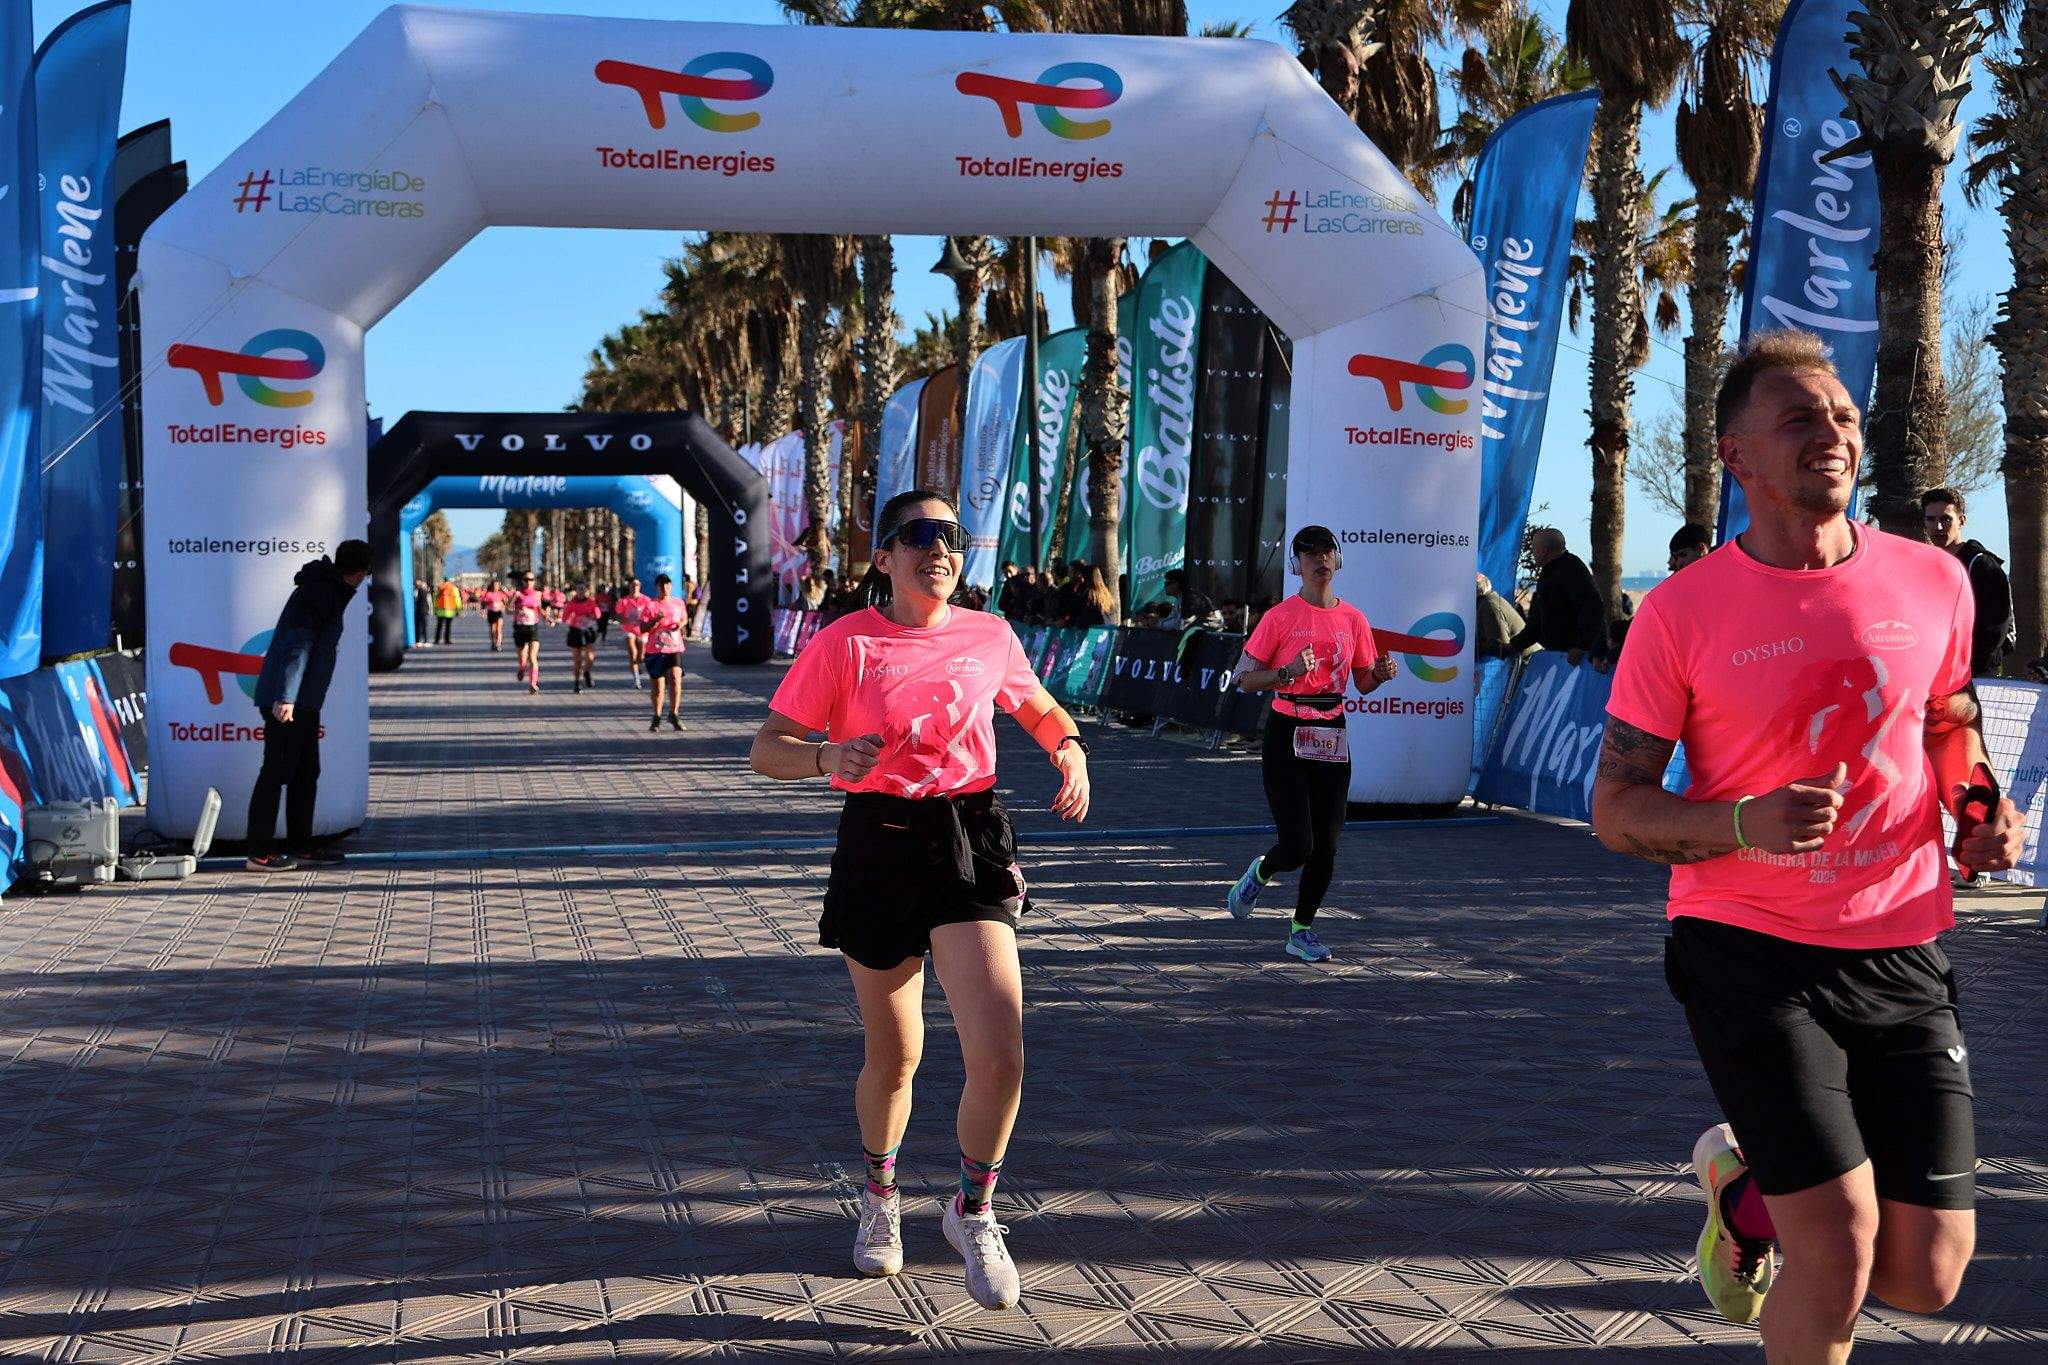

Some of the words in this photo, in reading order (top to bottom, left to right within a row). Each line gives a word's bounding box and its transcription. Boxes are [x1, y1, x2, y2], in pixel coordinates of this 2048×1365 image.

[596, 147, 775, 177] TotalEnergies
[955, 156, 1123, 182] TotalEnergies
[278, 190, 424, 218] LasCarreras
[1303, 214, 1425, 236] LasCarreras
[41, 174, 119, 415] Marlene
[1206, 368, 1262, 378] VOLV
[1137, 295, 1196, 514] Batiste
[168, 424, 326, 449] TotalEnergies
[454, 434, 652, 451] VOLVO
[1202, 433, 1258, 442] VOLV
[1345, 427, 1474, 452] TotalEnergies
[168, 536, 326, 556] totalenergies.es
[1341, 529, 1470, 547] totalenergies.es
[734, 508, 750, 645] VOLVO
[1732, 637, 1804, 666] OYSHO
[1344, 696, 1464, 720] otalEnergies
[168, 722, 326, 742] TotalEnes
[1811, 851, 1831, 867] DE
[1835, 851, 1848, 867] LA
[1809, 869, 1836, 884] 2025
